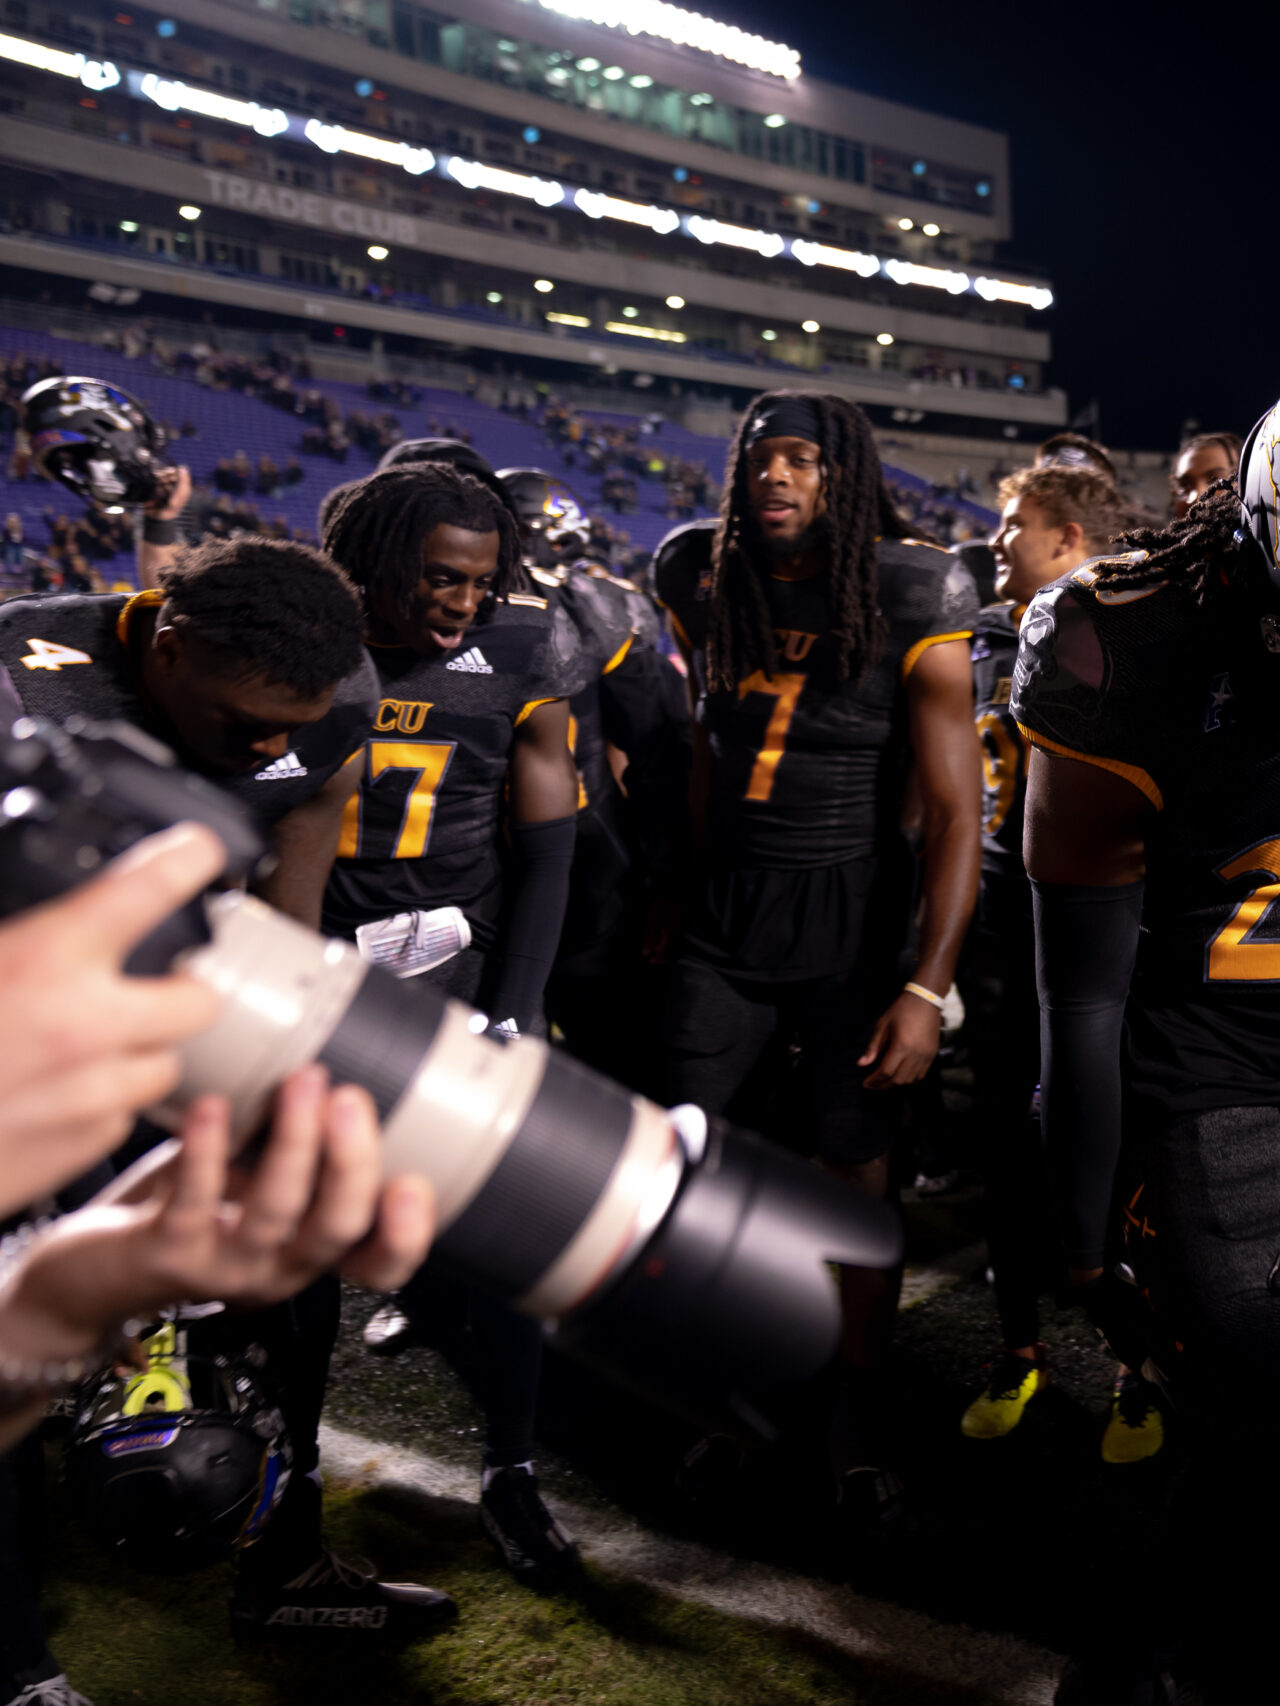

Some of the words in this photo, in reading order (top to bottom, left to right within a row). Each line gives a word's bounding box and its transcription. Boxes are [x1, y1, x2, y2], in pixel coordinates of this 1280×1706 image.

[205, 170, 324, 224] TRADE
[332, 203, 416, 245] CLUB
[19, 637, 94, 672] 4
[446, 662, 493, 674] adidas
[371, 698, 434, 734] CU
[254, 766, 308, 781] adidas
[263, 1604, 390, 1630] ADIZERO
